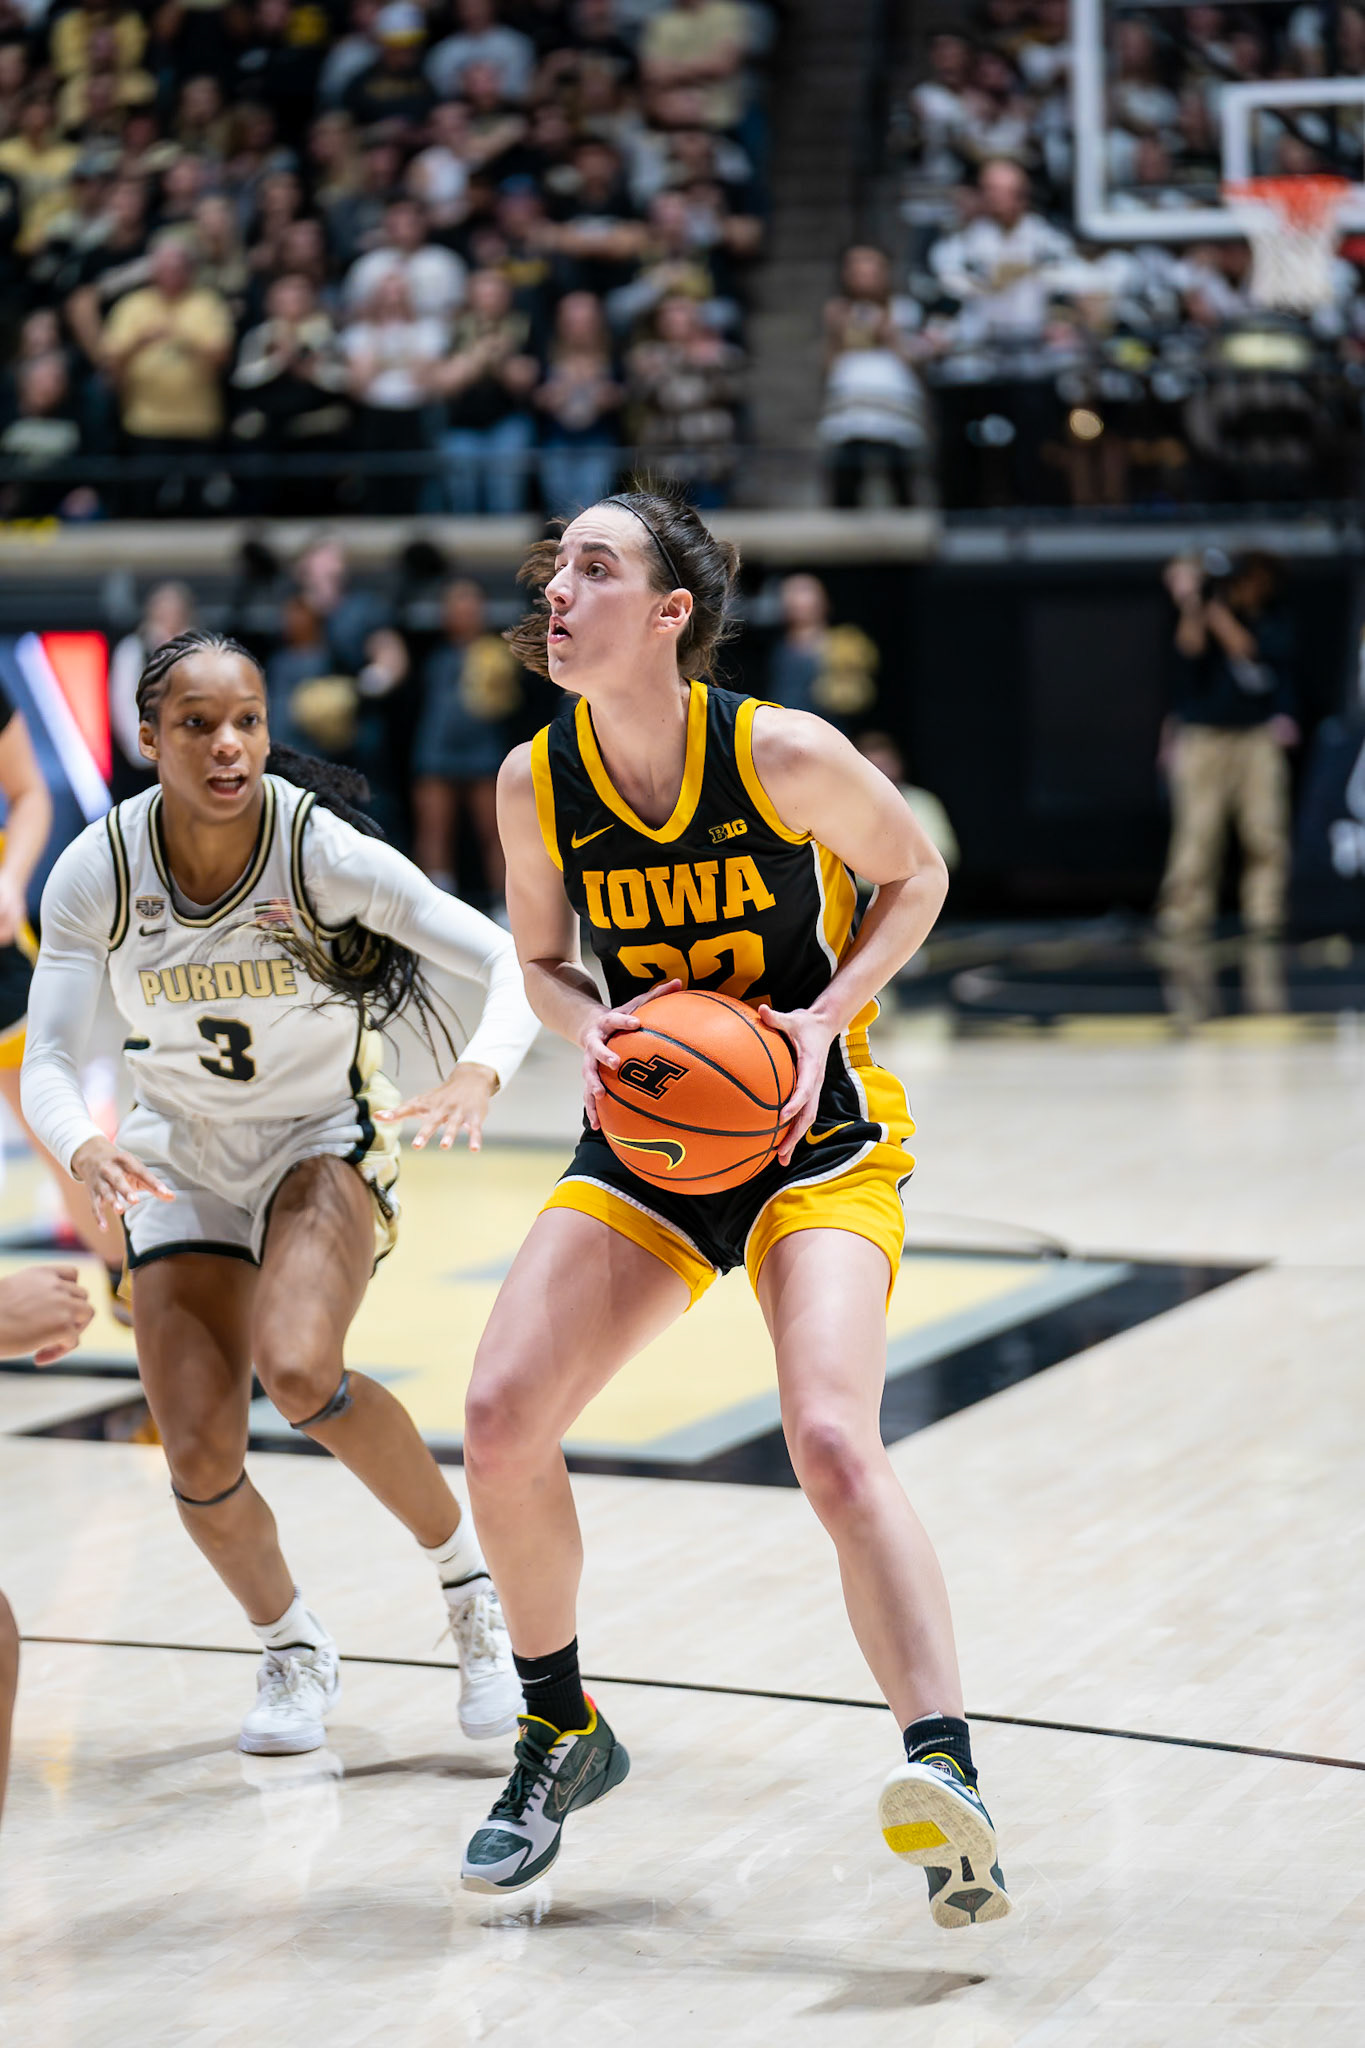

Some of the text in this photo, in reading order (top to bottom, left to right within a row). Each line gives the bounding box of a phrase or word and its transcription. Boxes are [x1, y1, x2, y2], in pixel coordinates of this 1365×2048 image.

[582, 855, 776, 929] IOWA
[138, 959, 298, 1006] PURDUE
[197, 1015, 257, 1082] 3
